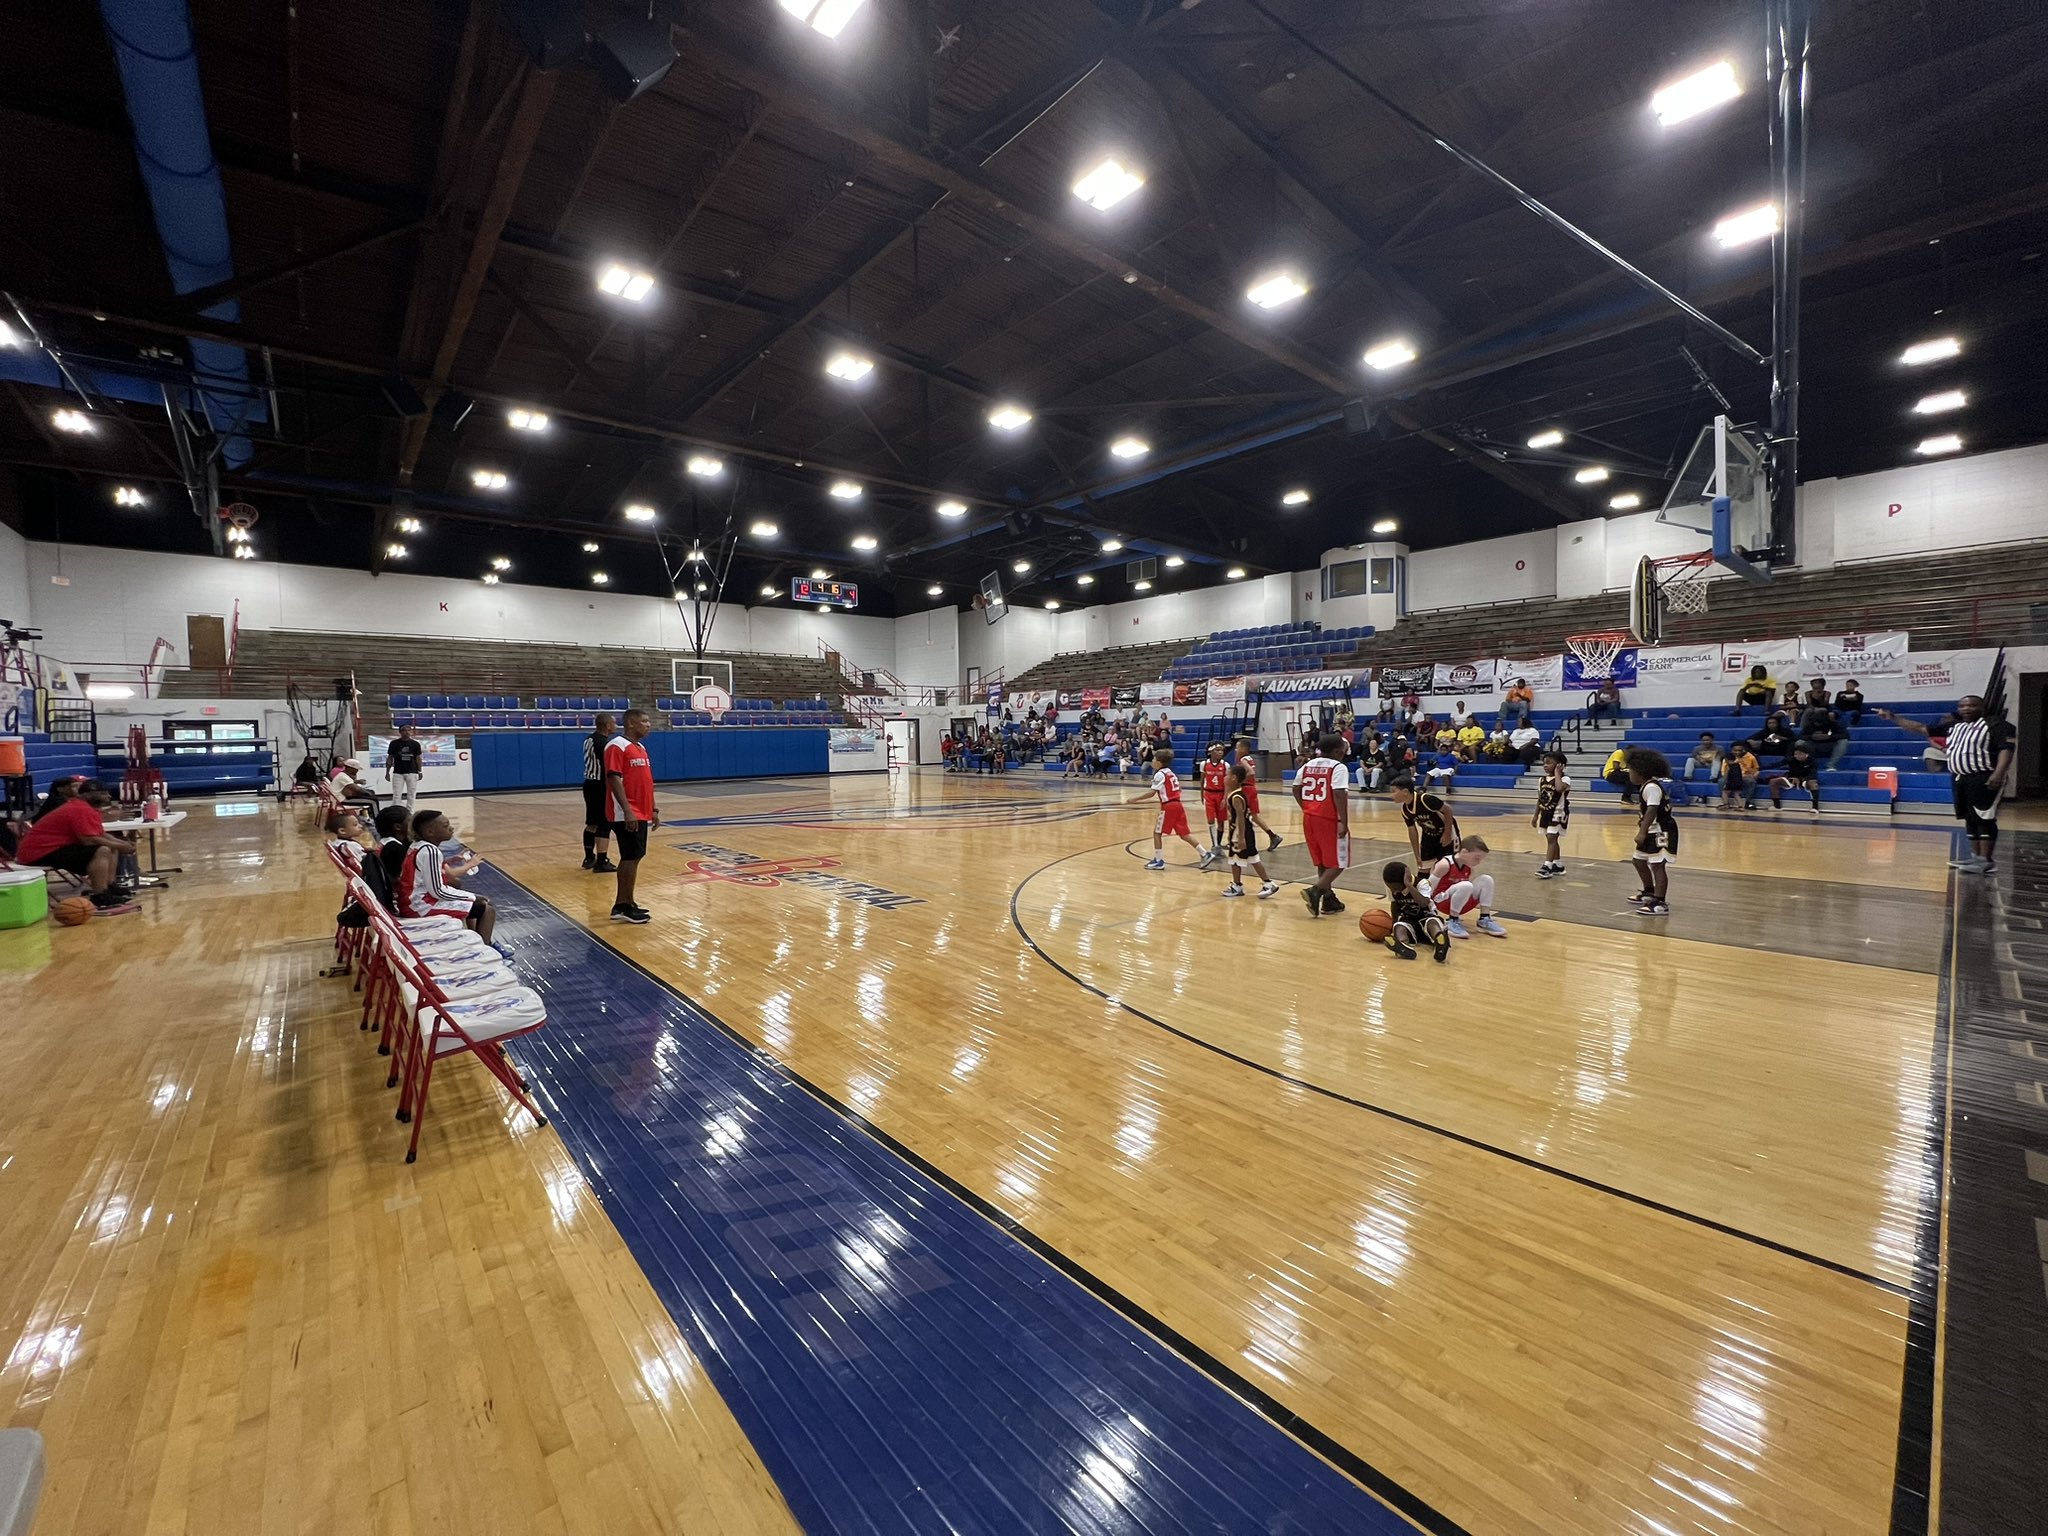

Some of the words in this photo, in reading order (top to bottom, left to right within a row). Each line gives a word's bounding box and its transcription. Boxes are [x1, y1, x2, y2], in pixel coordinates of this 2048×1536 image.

[1888, 503, 1902, 517] P
[1305, 591, 1313, 601] N
[439, 602, 449, 612] K
[1648, 654, 1712, 665] COMMERCIAL
[1813, 651, 1896, 663] NESHOBA
[1648, 663, 1673, 671] BANK
[1817, 660, 1890, 671] GENERAL
[1916, 663, 1943, 671] NCHS
[1908, 670, 1951, 679] STUDENT
[1910, 678, 1951, 686] SECTION
[459, 751, 469, 761] C
[1211, 775, 1219, 786] 4
[1301, 776, 1327, 802] 23
